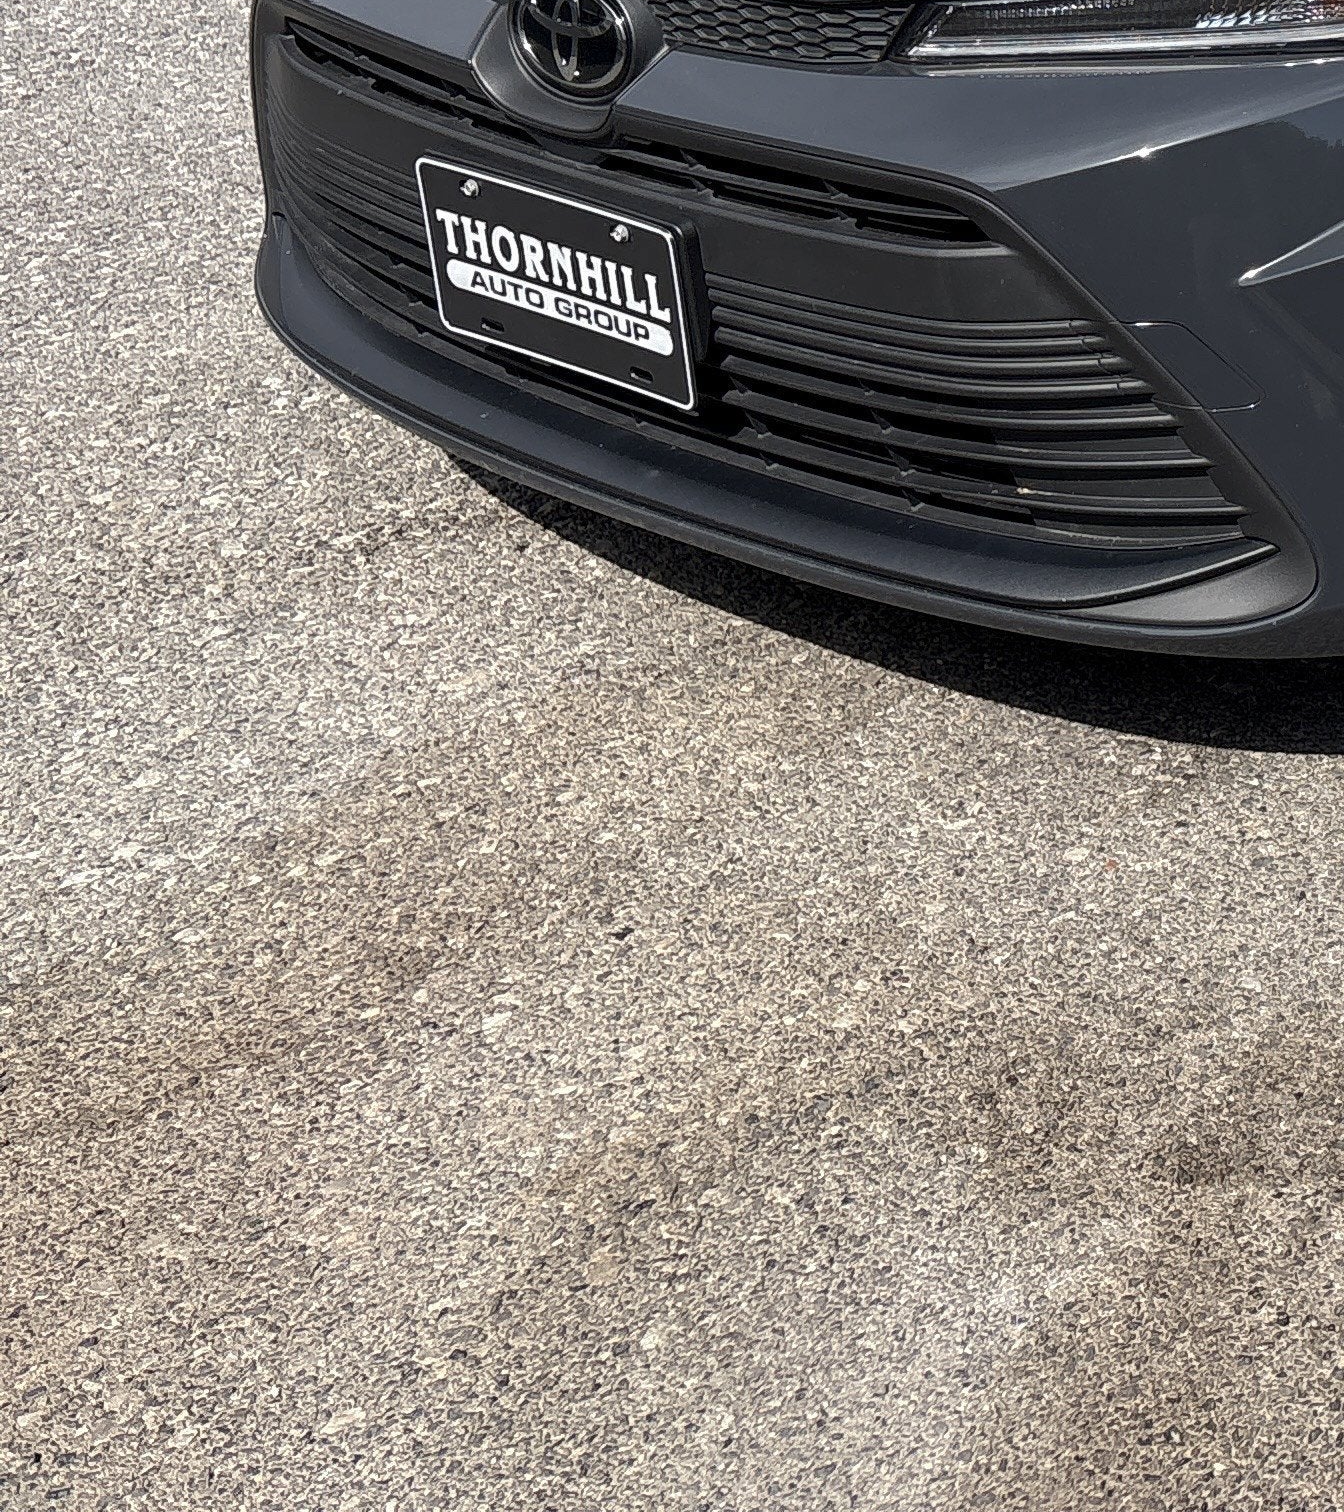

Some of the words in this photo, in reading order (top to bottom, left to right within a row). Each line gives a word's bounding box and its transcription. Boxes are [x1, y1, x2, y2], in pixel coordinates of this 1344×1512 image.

[435, 208, 671, 323] THORNHILL
[470, 270, 545, 310] AUTO
[553, 296, 650, 342] GROUP
